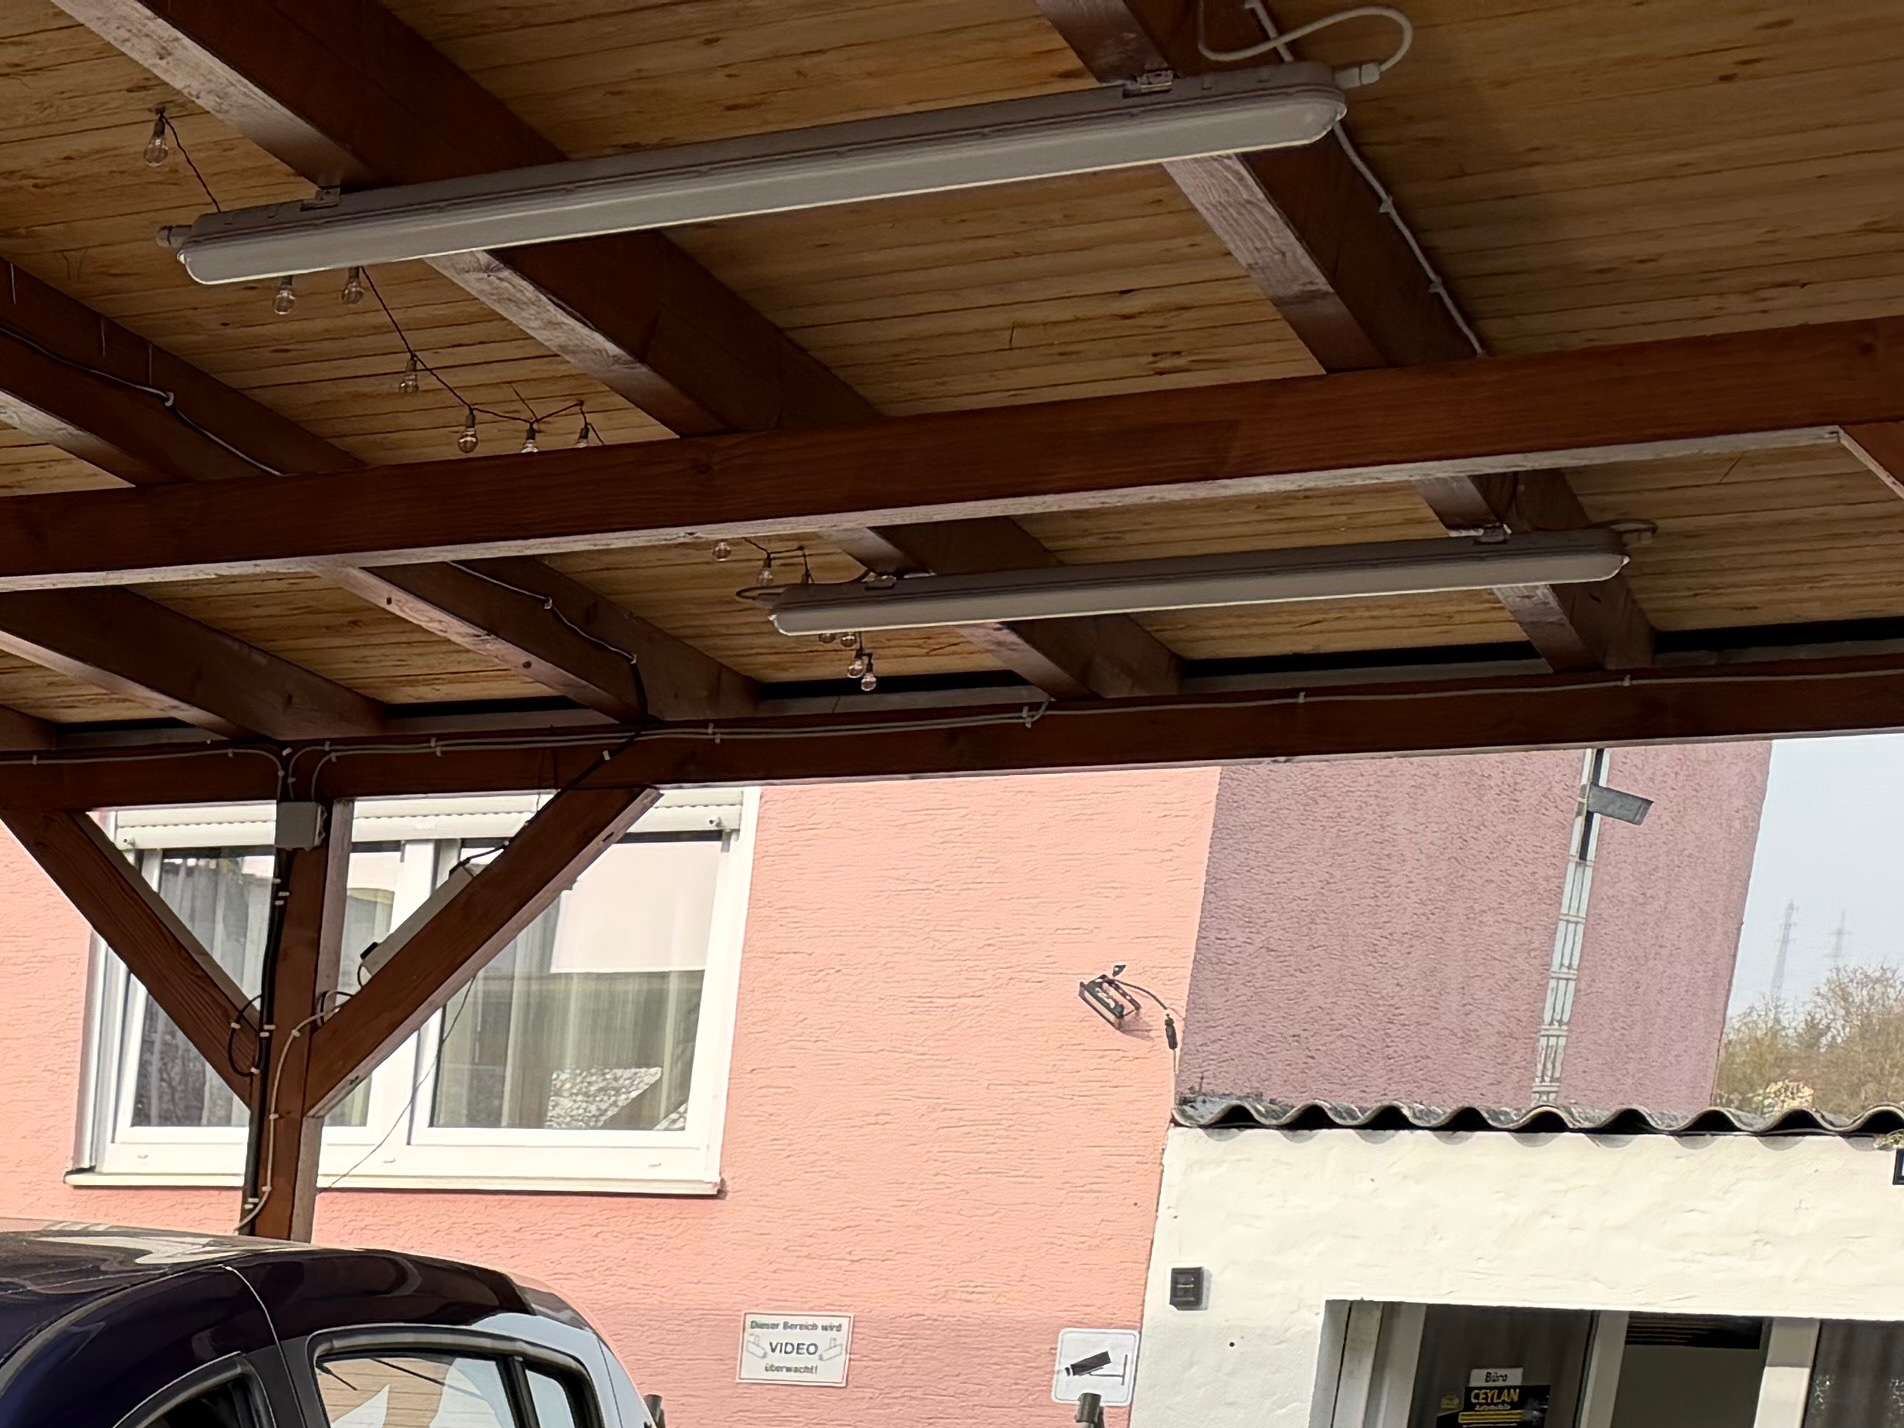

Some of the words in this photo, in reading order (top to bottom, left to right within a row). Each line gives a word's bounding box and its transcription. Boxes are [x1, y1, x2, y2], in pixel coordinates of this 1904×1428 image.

[750, 1320, 780, 1330] Dieser
[783, 1321, 819, 1331] Bereich
[821, 1322, 843, 1332] wird
[769, 1341, 819, 1356] VIDEO
[1471, 1388, 1520, 1403] CEYLAN
